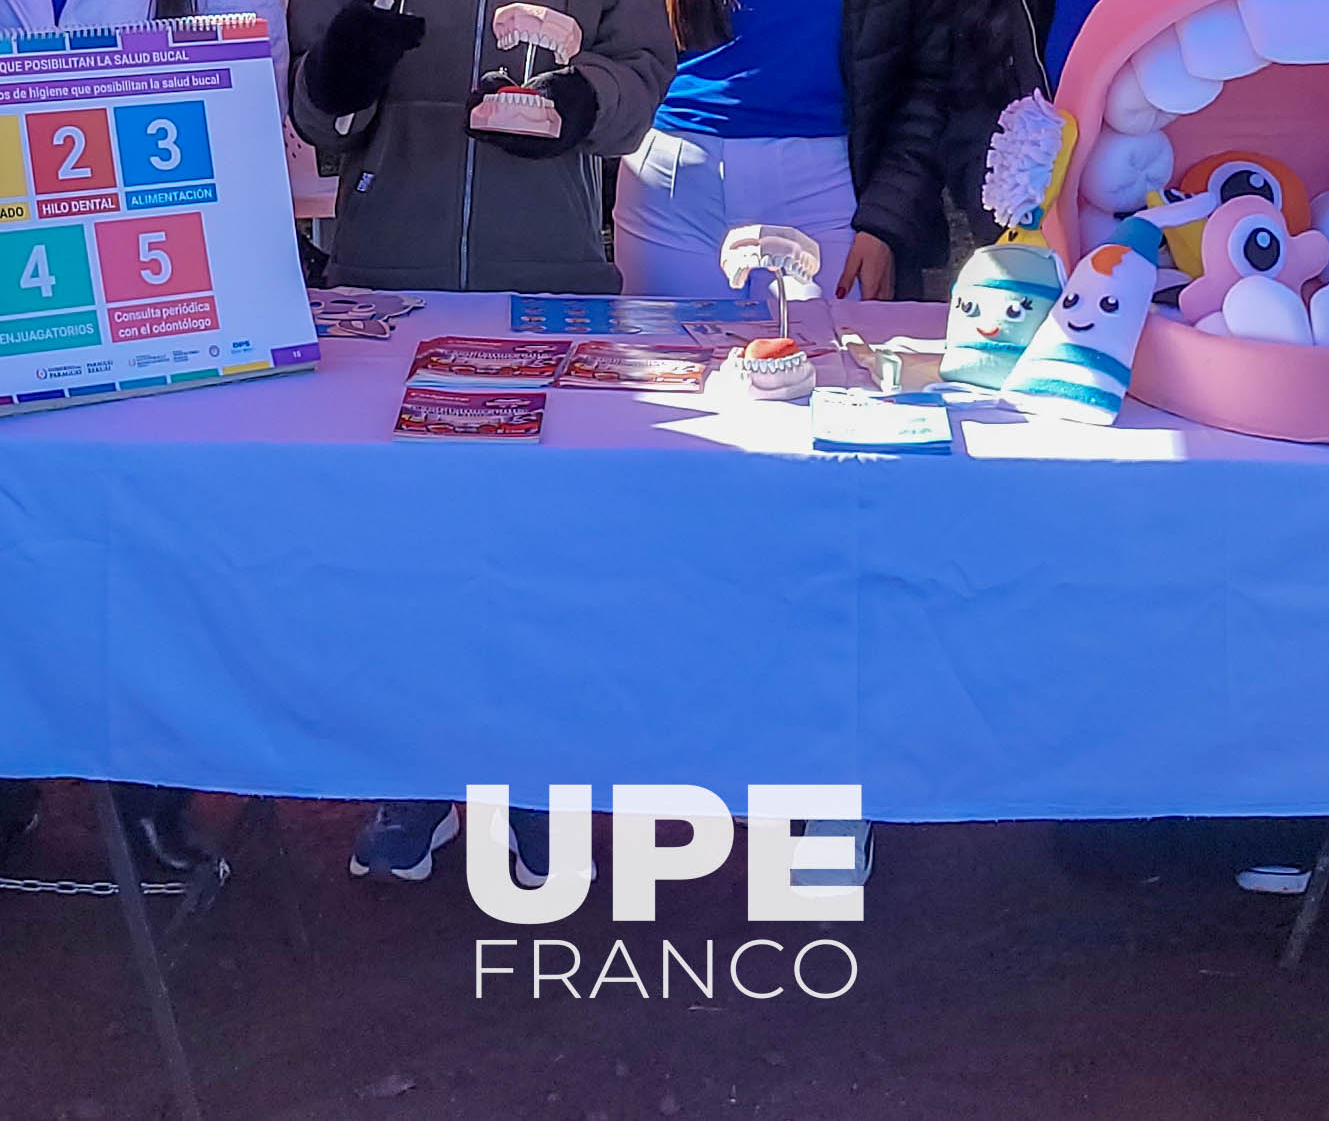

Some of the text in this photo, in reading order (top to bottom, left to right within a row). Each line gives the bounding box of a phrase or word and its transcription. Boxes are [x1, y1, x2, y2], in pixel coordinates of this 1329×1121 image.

[24, 56, 95, 72] POSIBILITAN
[97, 54, 112, 67] LA
[113, 52, 150, 65] SALUD
[152, 50, 190, 63] BUCAL
[12, 86, 27, 100] de
[28, 83, 69, 101] higiene
[71, 85, 92, 99] que
[93, 78, 148, 96] posibilitan
[150, 77, 160, 90] la
[161, 75, 190, 88] salud
[191, 73, 221, 87] bucal
[52, 126, 92, 180] 2
[146, 118, 181, 171] 3
[42, 198, 115, 216] HILO DENTAL
[131, 187, 213, 207] ALIMENTACIÓN
[20, 231, 173, 297] 4 5
[114, 302, 210, 323] Consulta periódica
[118, 317, 212, 338] con el odontólogo
